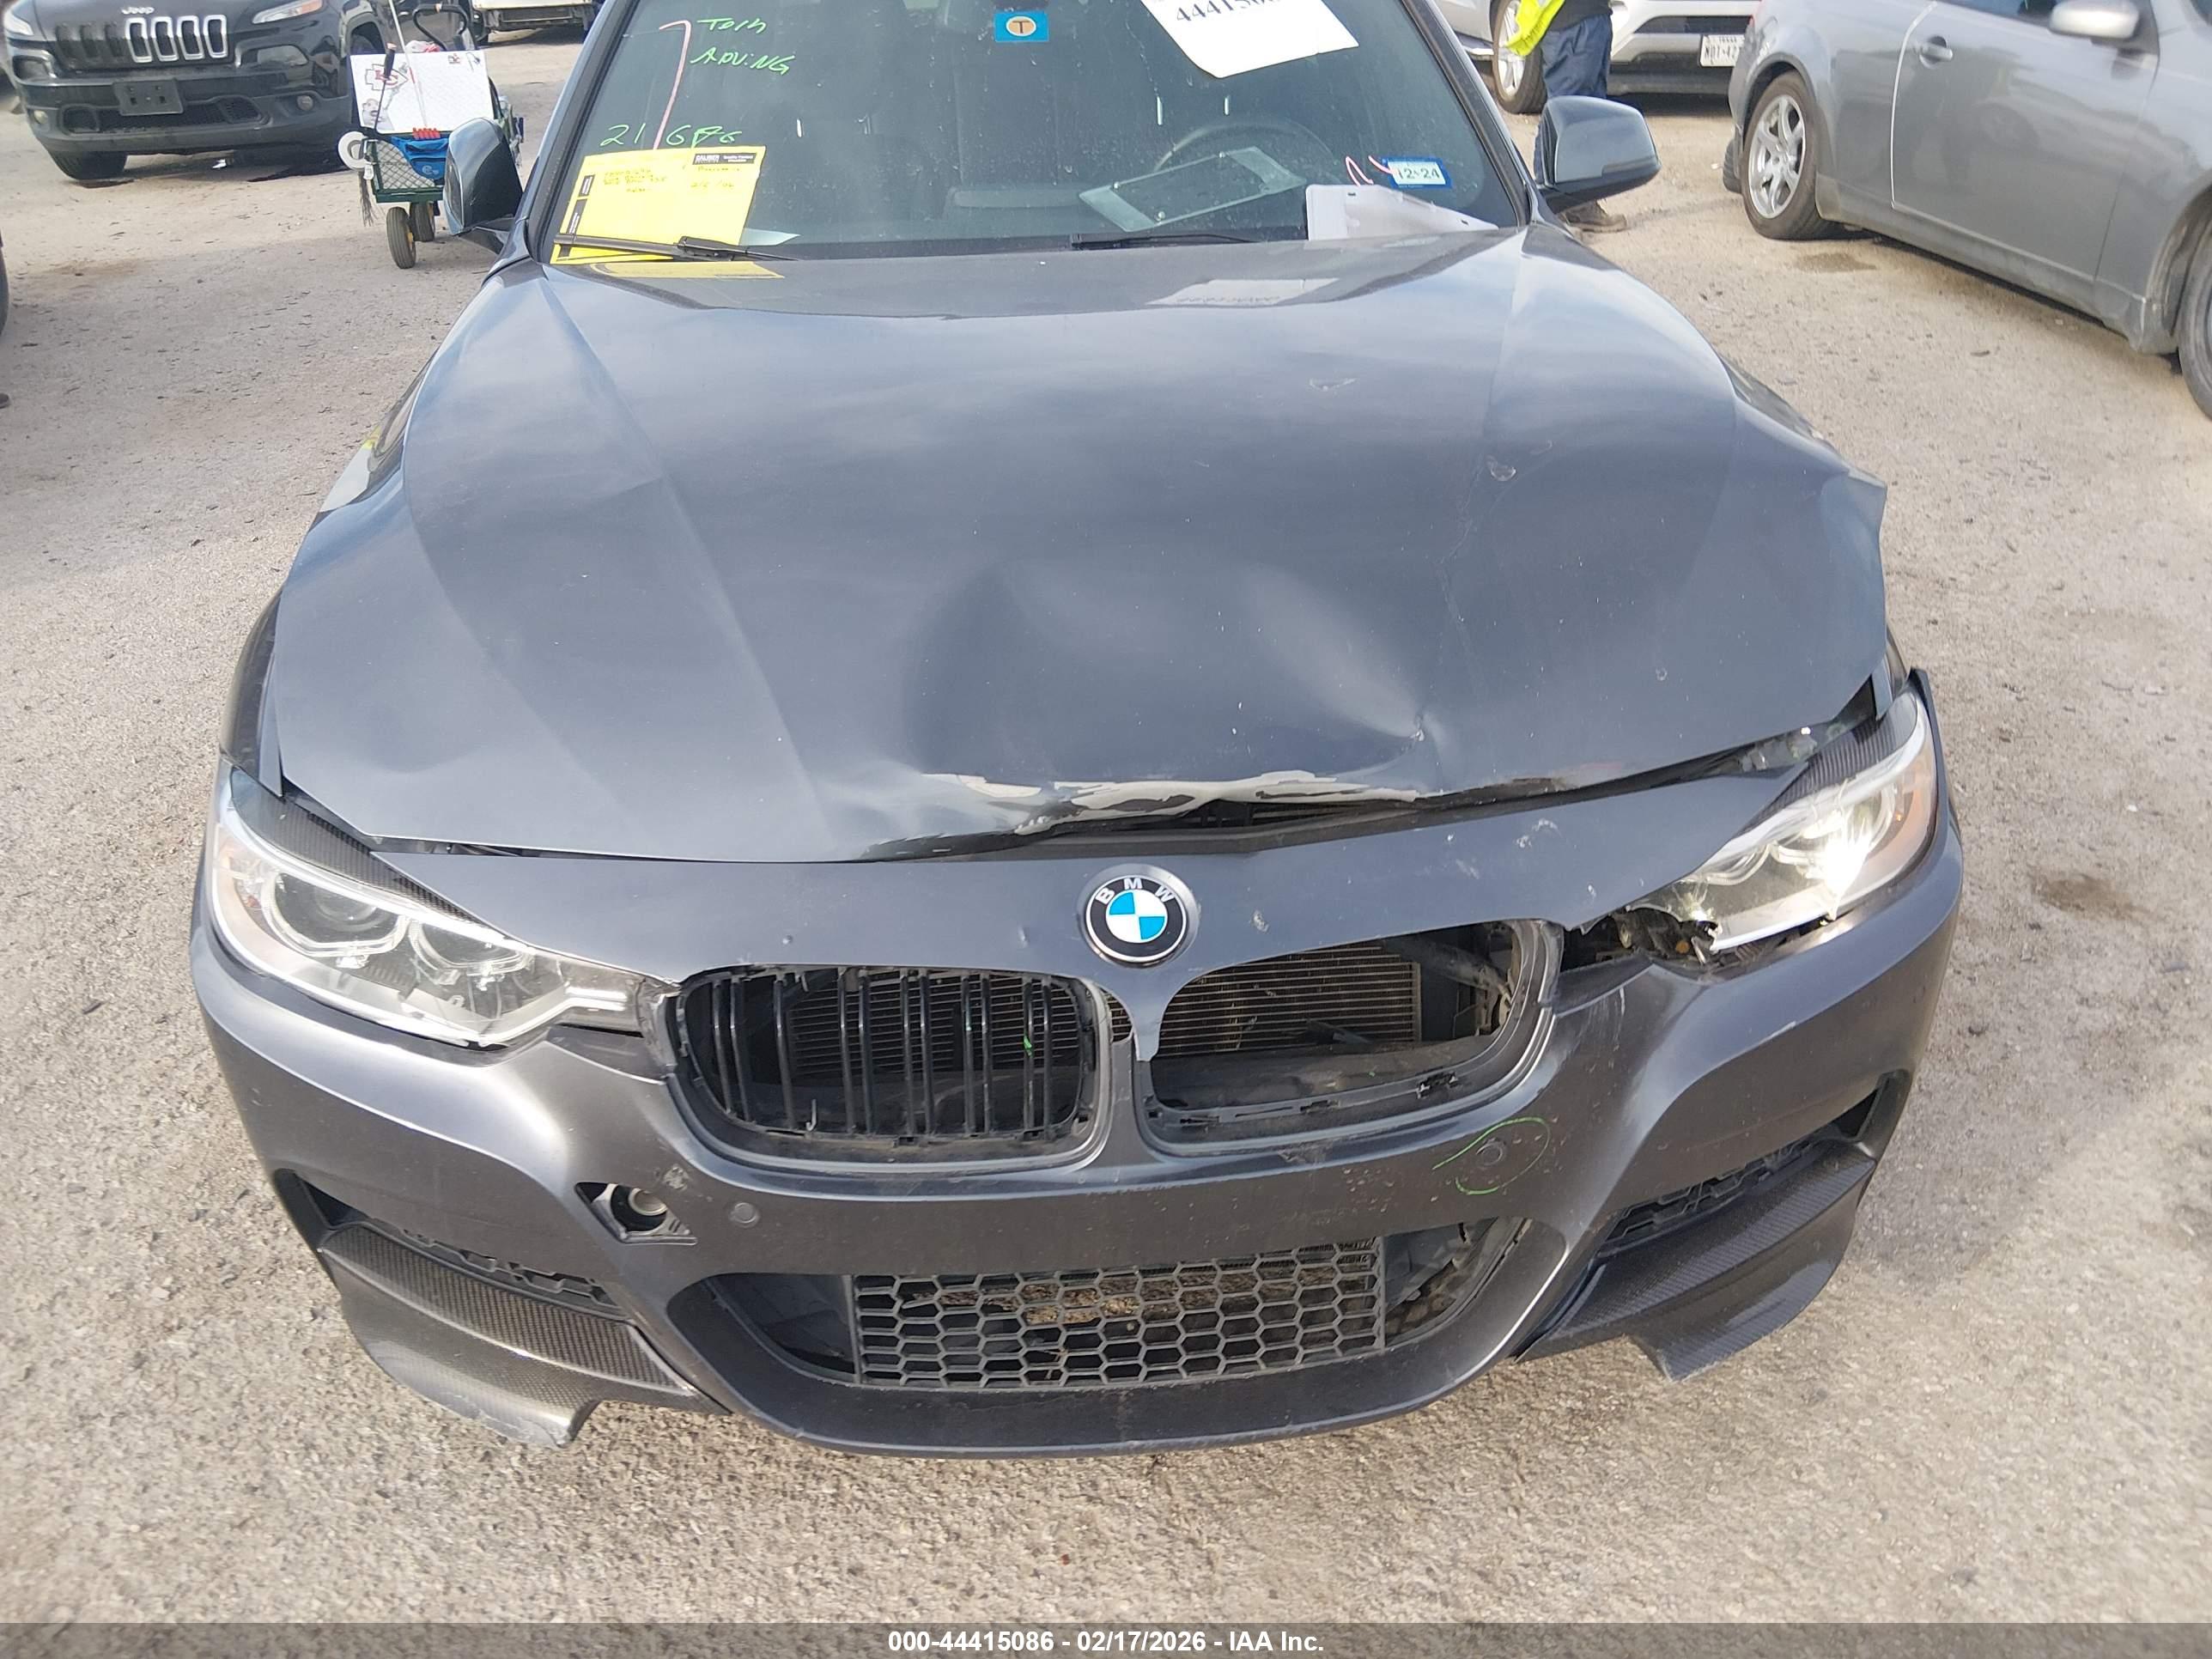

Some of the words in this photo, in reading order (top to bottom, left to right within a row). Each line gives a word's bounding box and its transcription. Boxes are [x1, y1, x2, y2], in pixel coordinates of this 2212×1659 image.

[121, 6, 155, 15] Jeep
[1012, 20, 1031, 34] T
[1095, 878, 1176, 905] BMW
